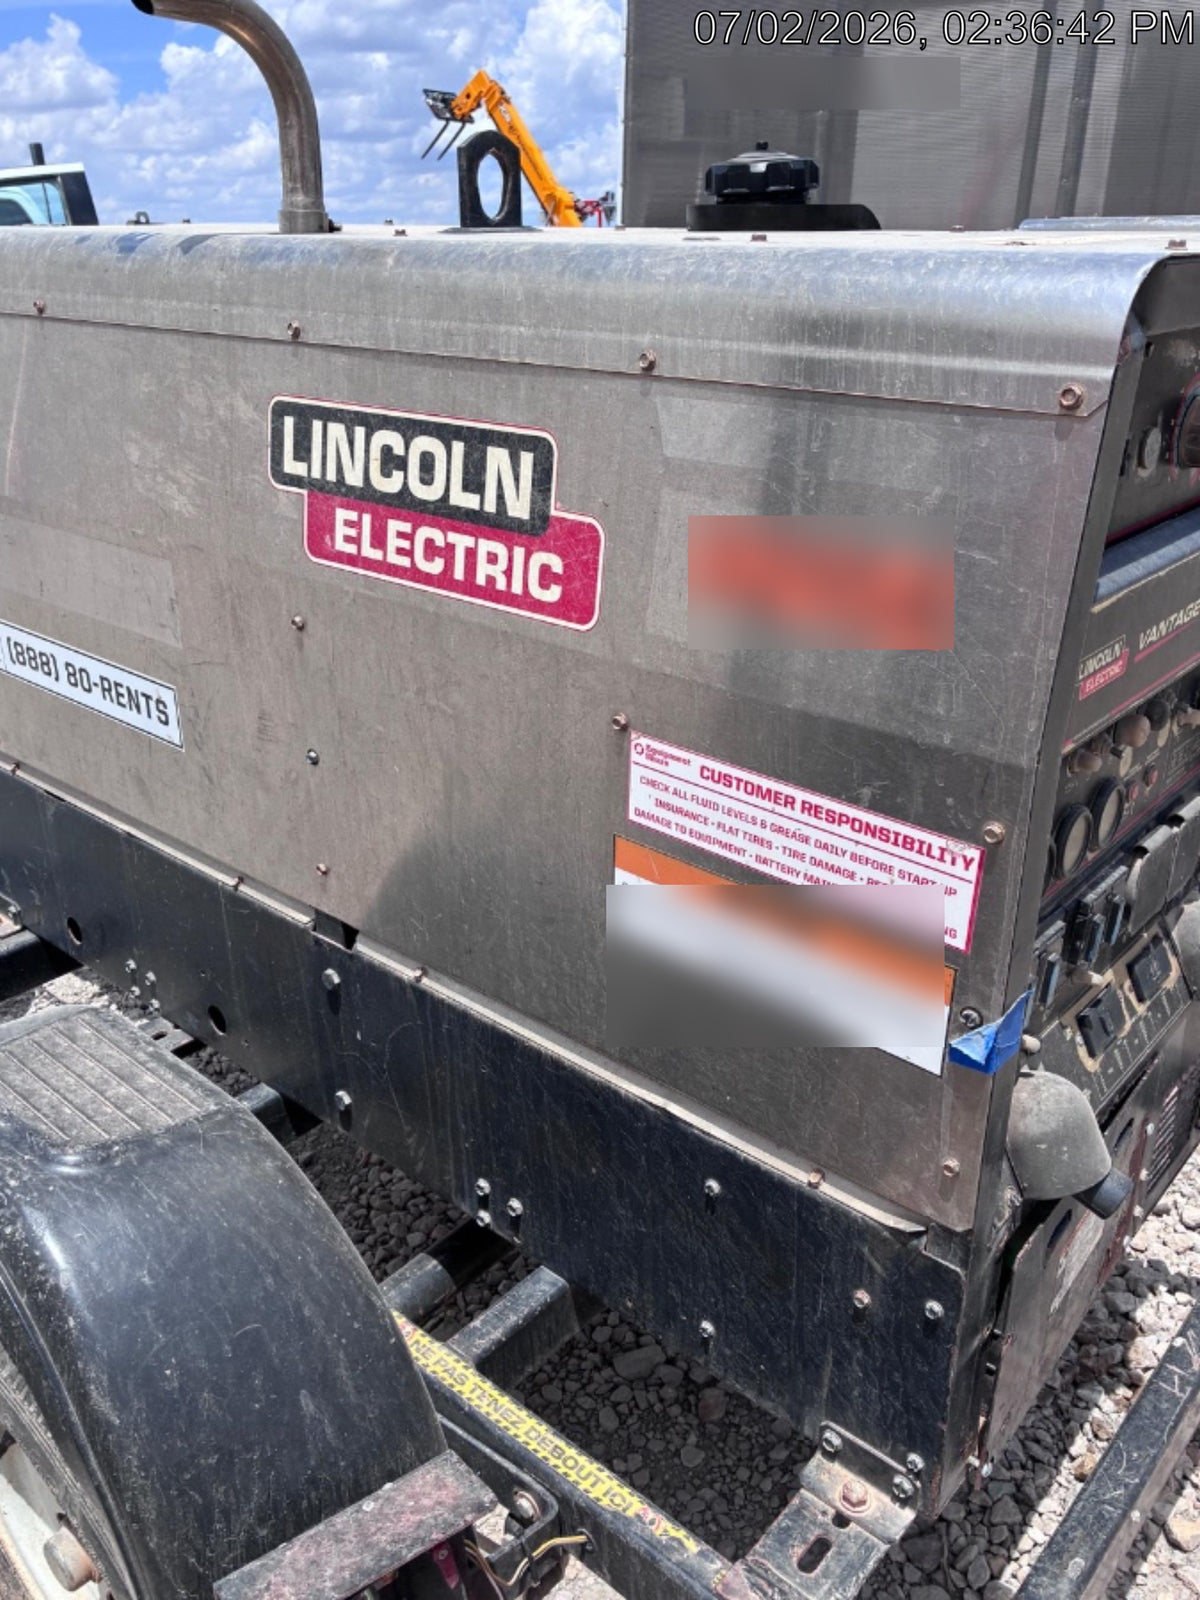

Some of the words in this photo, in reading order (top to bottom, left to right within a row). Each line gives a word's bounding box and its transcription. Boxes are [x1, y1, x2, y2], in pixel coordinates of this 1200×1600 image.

[283, 415, 534, 520] LINCOLN
[334, 507, 564, 603] ELECTRIC
[1139, 599, 1200, 650] VANTAGE
[7, 636, 60, 682] (888)
[65, 661, 170, 726] 80-RENTS
[634, 807, 673, 829] DAMAGE
[674, 822, 687, 835] TO
[689, 829, 748, 858] EQUIPMENT
[755, 853, 801, 879] BATTERY
[640, 776, 670, 793] CHECK
[672, 787, 689, 801] ALL
[690, 794, 720, 812] FLUID
[721, 805, 758, 825] LEVELS
[769, 823, 811, 845] GREASE
[814, 839, 848, 858] DAILY
[850, 852, 895, 876] BEFORE
[654, 798, 710, 826] INSURANCE
[716, 821, 740, 838] FLAT
[742, 829, 773, 850] TIRES
[781, 846, 806, 862] TIRE
[809, 856, 857, 881] DAMAGE
[700, 765, 797, 811] CUSTOMER
[800, 800, 975, 871] RESPONSIBILITY
[410, 1340, 436, 1360] NE
[433, 1360, 469, 1386] PAS
[469, 1382, 527, 1428] TENEZ
[525, 1426, 605, 1489] DEBOUT
